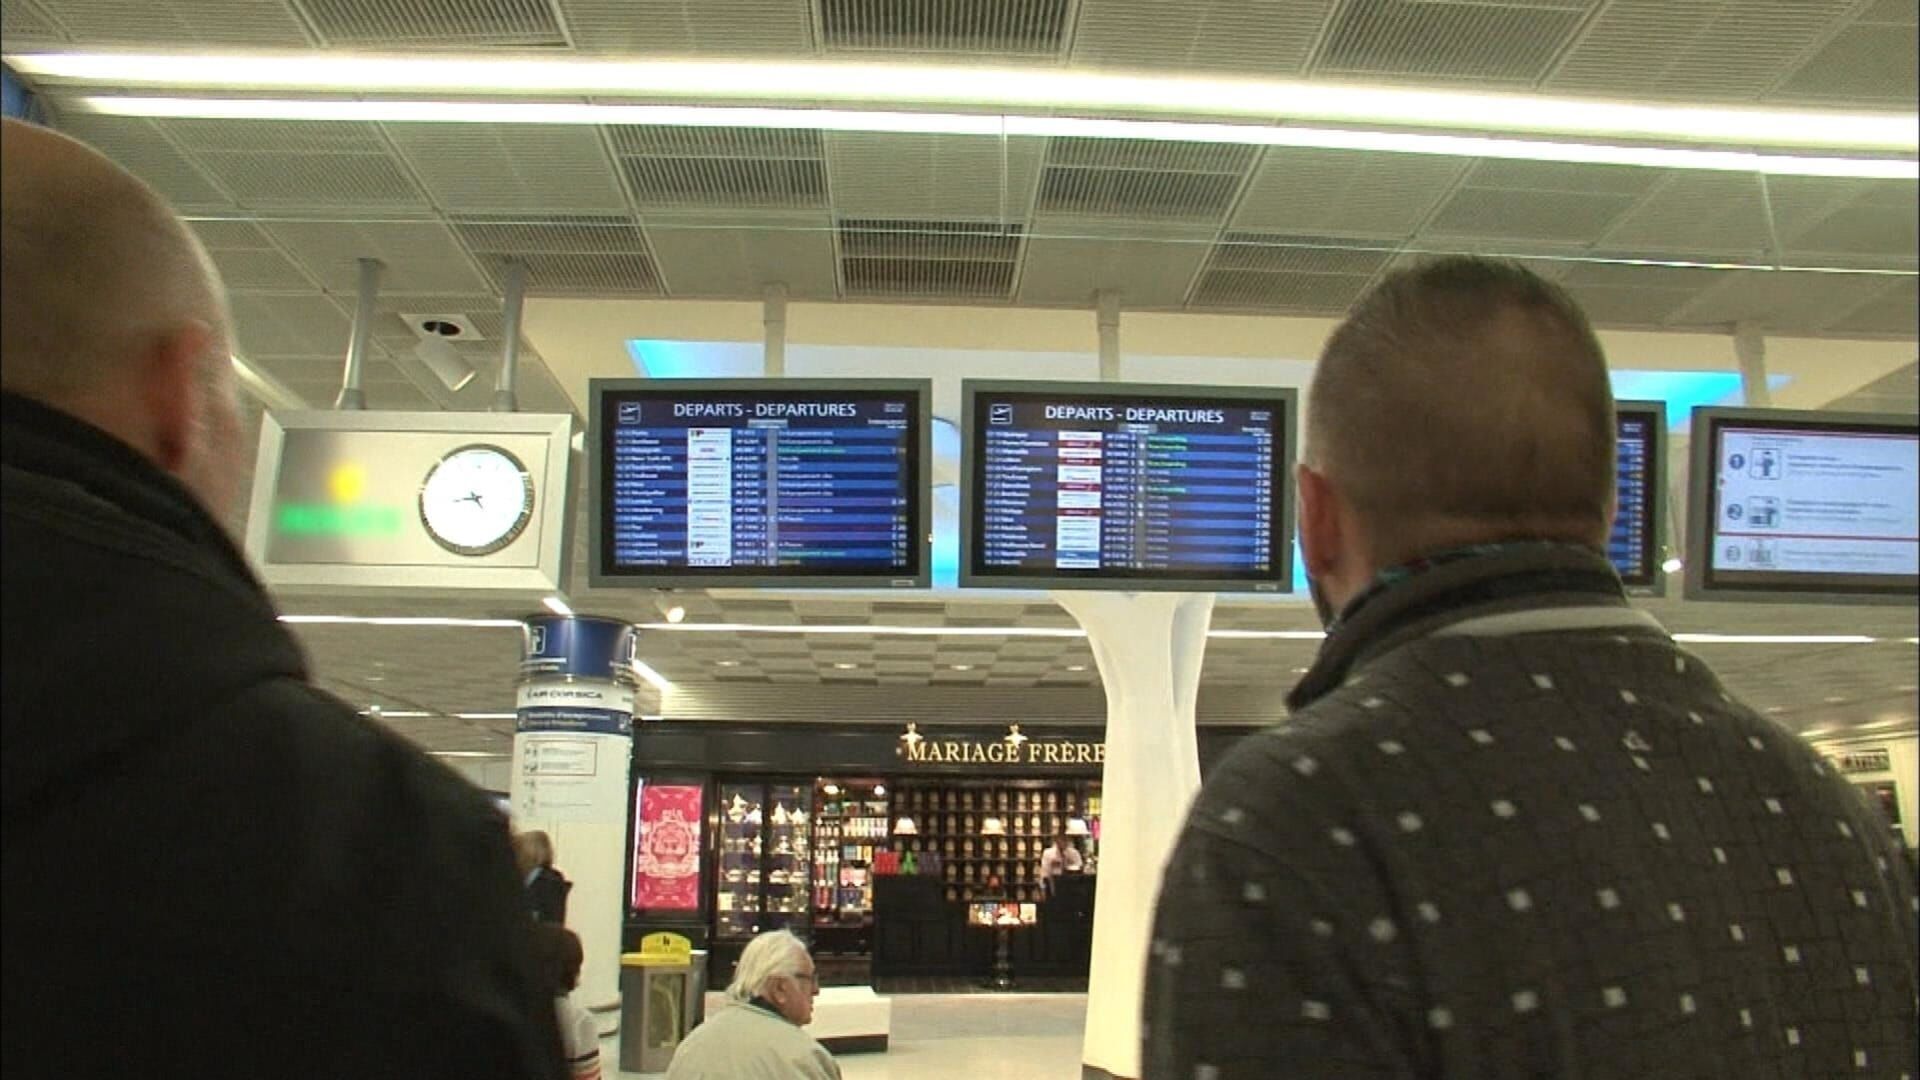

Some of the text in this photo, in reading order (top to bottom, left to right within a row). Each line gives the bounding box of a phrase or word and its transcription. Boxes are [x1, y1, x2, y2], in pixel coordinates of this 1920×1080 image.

[674, 403, 743, 417] DEPARTS
[755, 403, 857, 417] DEPARTURES
[1045, 405, 1114, 420] DEPARTS
[1125, 408, 1225, 423] DEPARTURES
[907, 742, 1020, 762] MARIAGE
